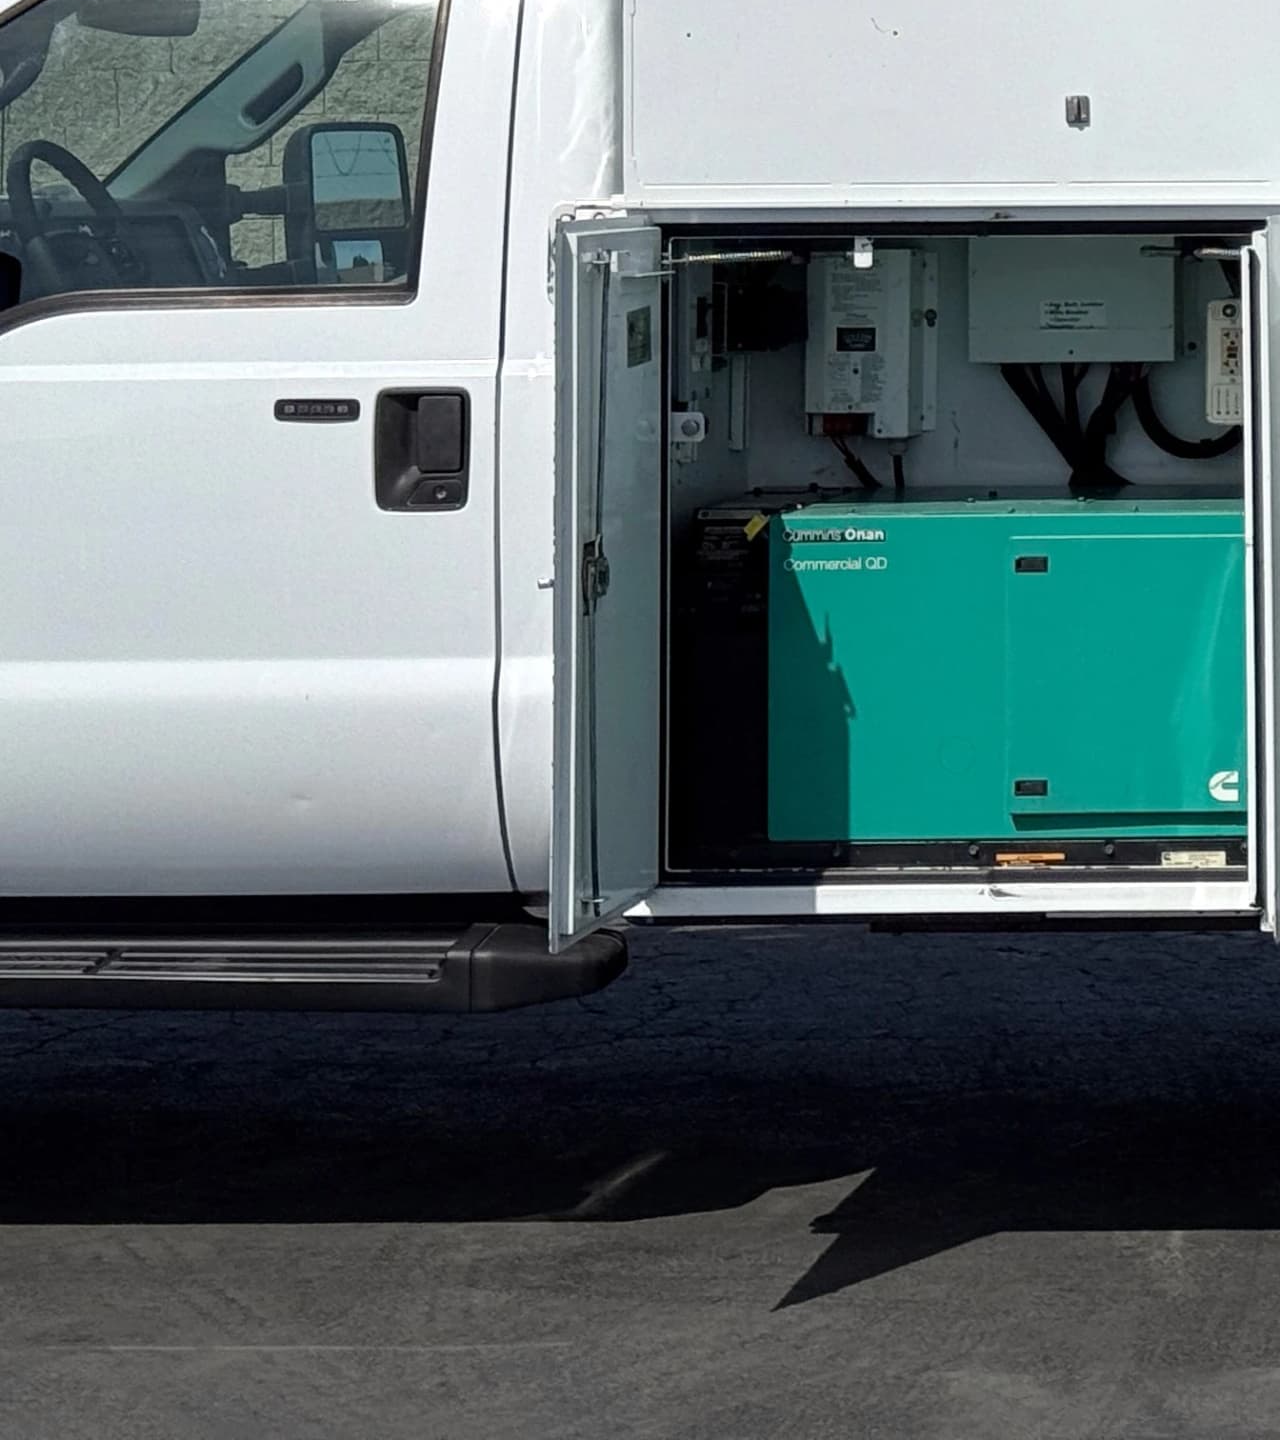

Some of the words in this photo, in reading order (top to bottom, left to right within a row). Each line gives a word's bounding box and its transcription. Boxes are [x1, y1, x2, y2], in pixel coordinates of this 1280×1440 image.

[783, 528, 841, 542] Cummins
[844, 528, 884, 541] Onan
[784, 557, 862, 571] Commercial
[865, 556, 888, 570] QD
